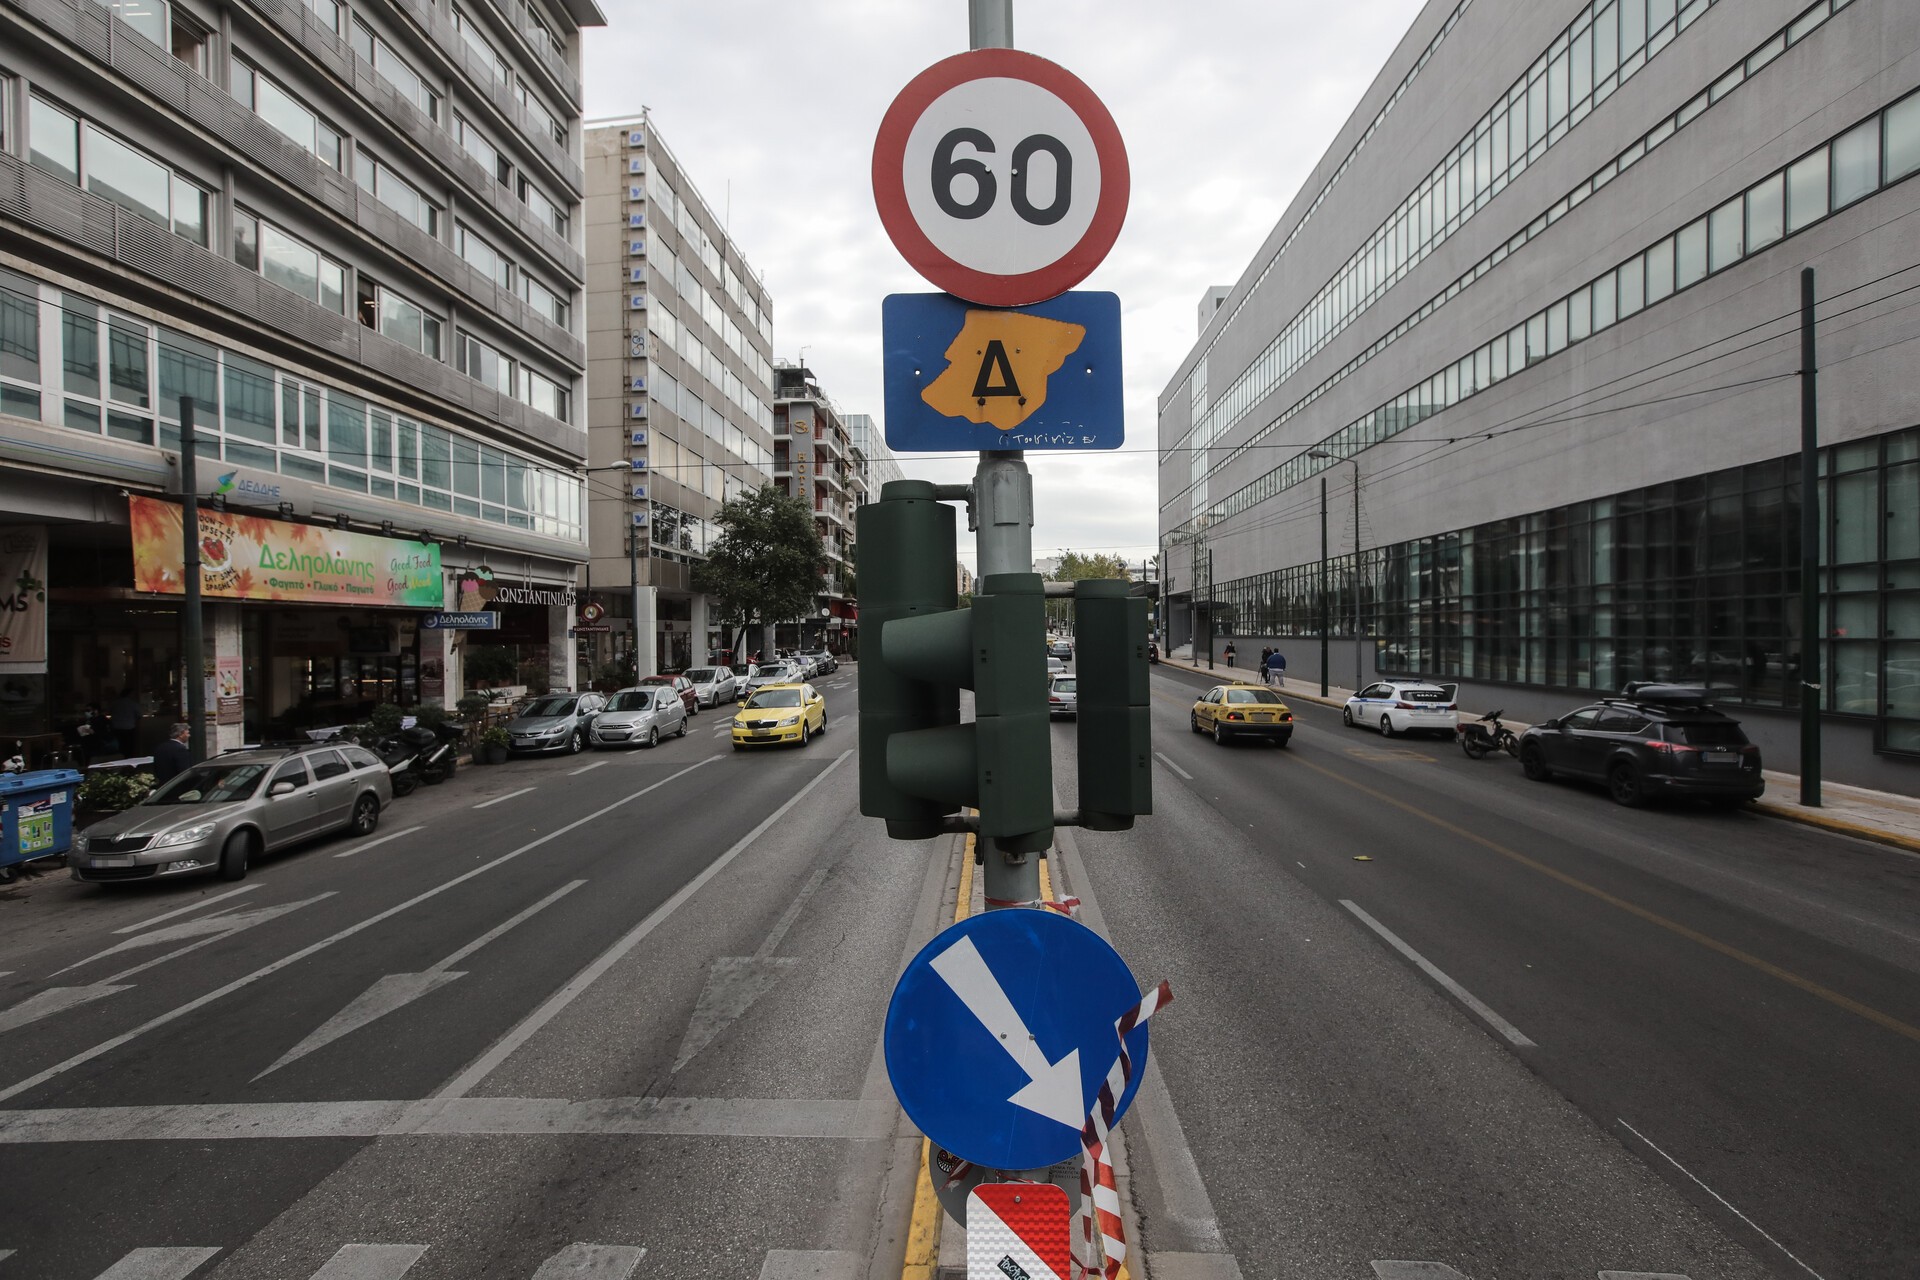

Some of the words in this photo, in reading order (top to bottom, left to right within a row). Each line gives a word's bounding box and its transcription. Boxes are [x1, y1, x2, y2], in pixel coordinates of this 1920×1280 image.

[931, 127, 1073, 226] 60
[630, 132, 645, 307] OLYMPIC
[632, 379, 647, 524] AIRWAY
[238, 479, 281, 497] ΔΕΔΔΗΕ
[798, 451, 807, 496] HOTE
[205, 574, 217, 582] EAT
[259, 543, 375, 583] Δεληολάνης
[269, 577, 304, 591] Φαγητό
[313, 580, 338, 592] Γλυκό
[345, 583, 374, 595] Παγωτό
[440, 614, 488, 625] Δεληολάνης
